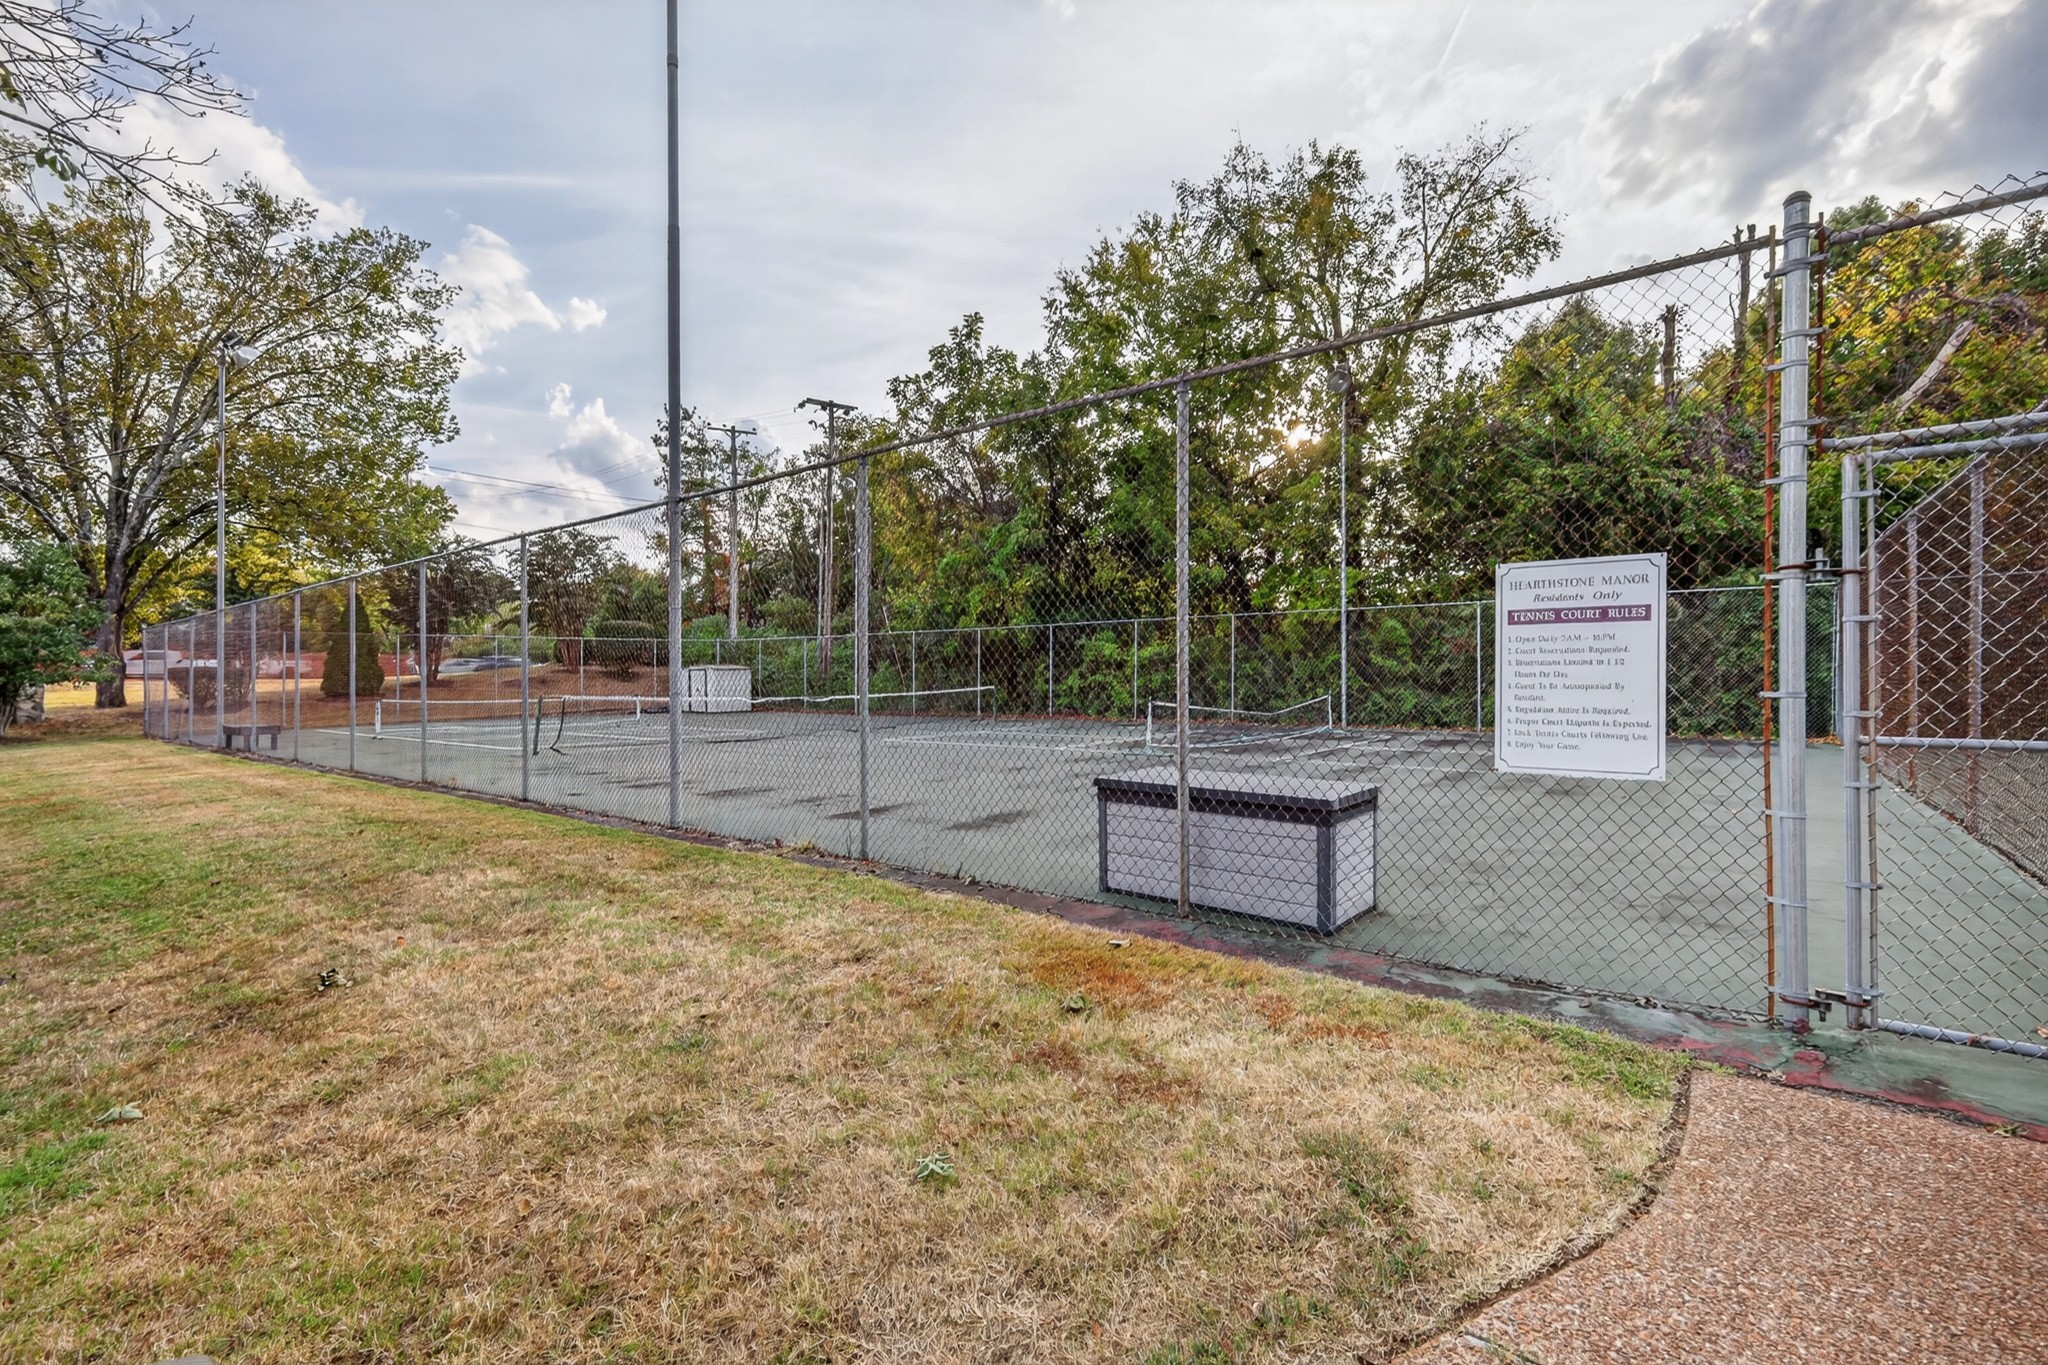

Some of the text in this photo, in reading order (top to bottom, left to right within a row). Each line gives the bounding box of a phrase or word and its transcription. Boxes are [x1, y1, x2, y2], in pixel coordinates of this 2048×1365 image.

[1510, 574, 1649, 591] HEARTHSTONE MANOR
[1533, 590, 1623, 602] Residents Only
[1512, 607, 1646, 621] TENNIS COURT RULES
